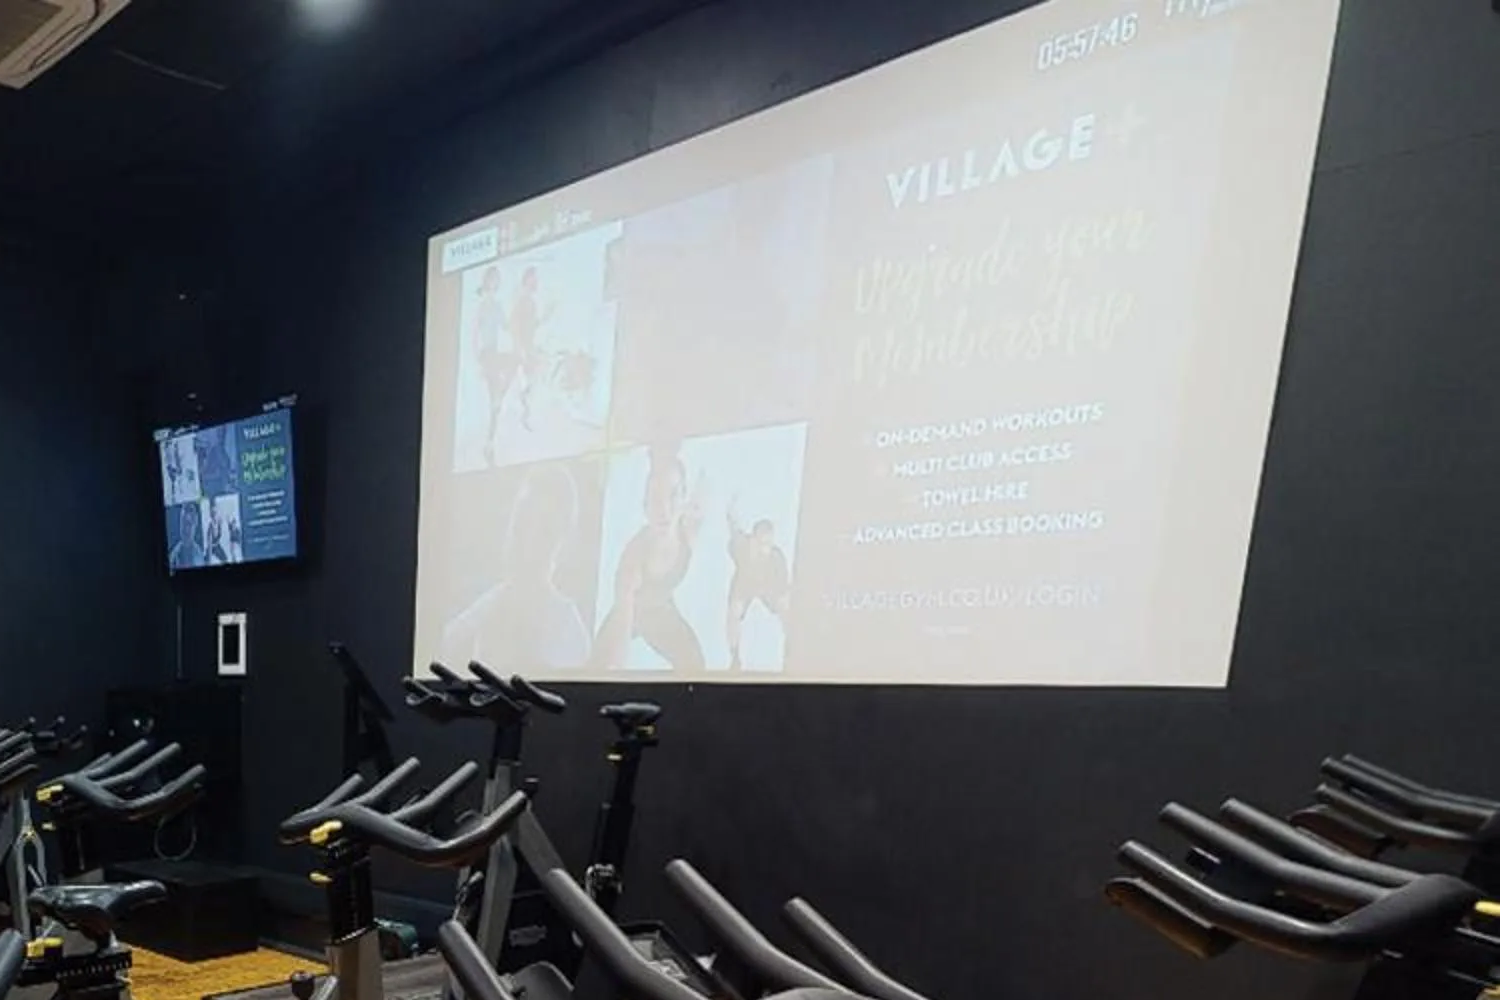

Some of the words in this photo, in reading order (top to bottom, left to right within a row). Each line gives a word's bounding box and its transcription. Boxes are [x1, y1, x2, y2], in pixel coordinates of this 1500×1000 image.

[885, 114, 1095, 208] VILLAGE
[992, 401, 1106, 432] WORKOUTS
[946, 451, 994, 473] CLUB
[999, 441, 1074, 467] ACCESS
[922, 488, 979, 508] TOWEL
[852, 523, 944, 546] ADVANCED
[946, 516, 1004, 539] CLASS
